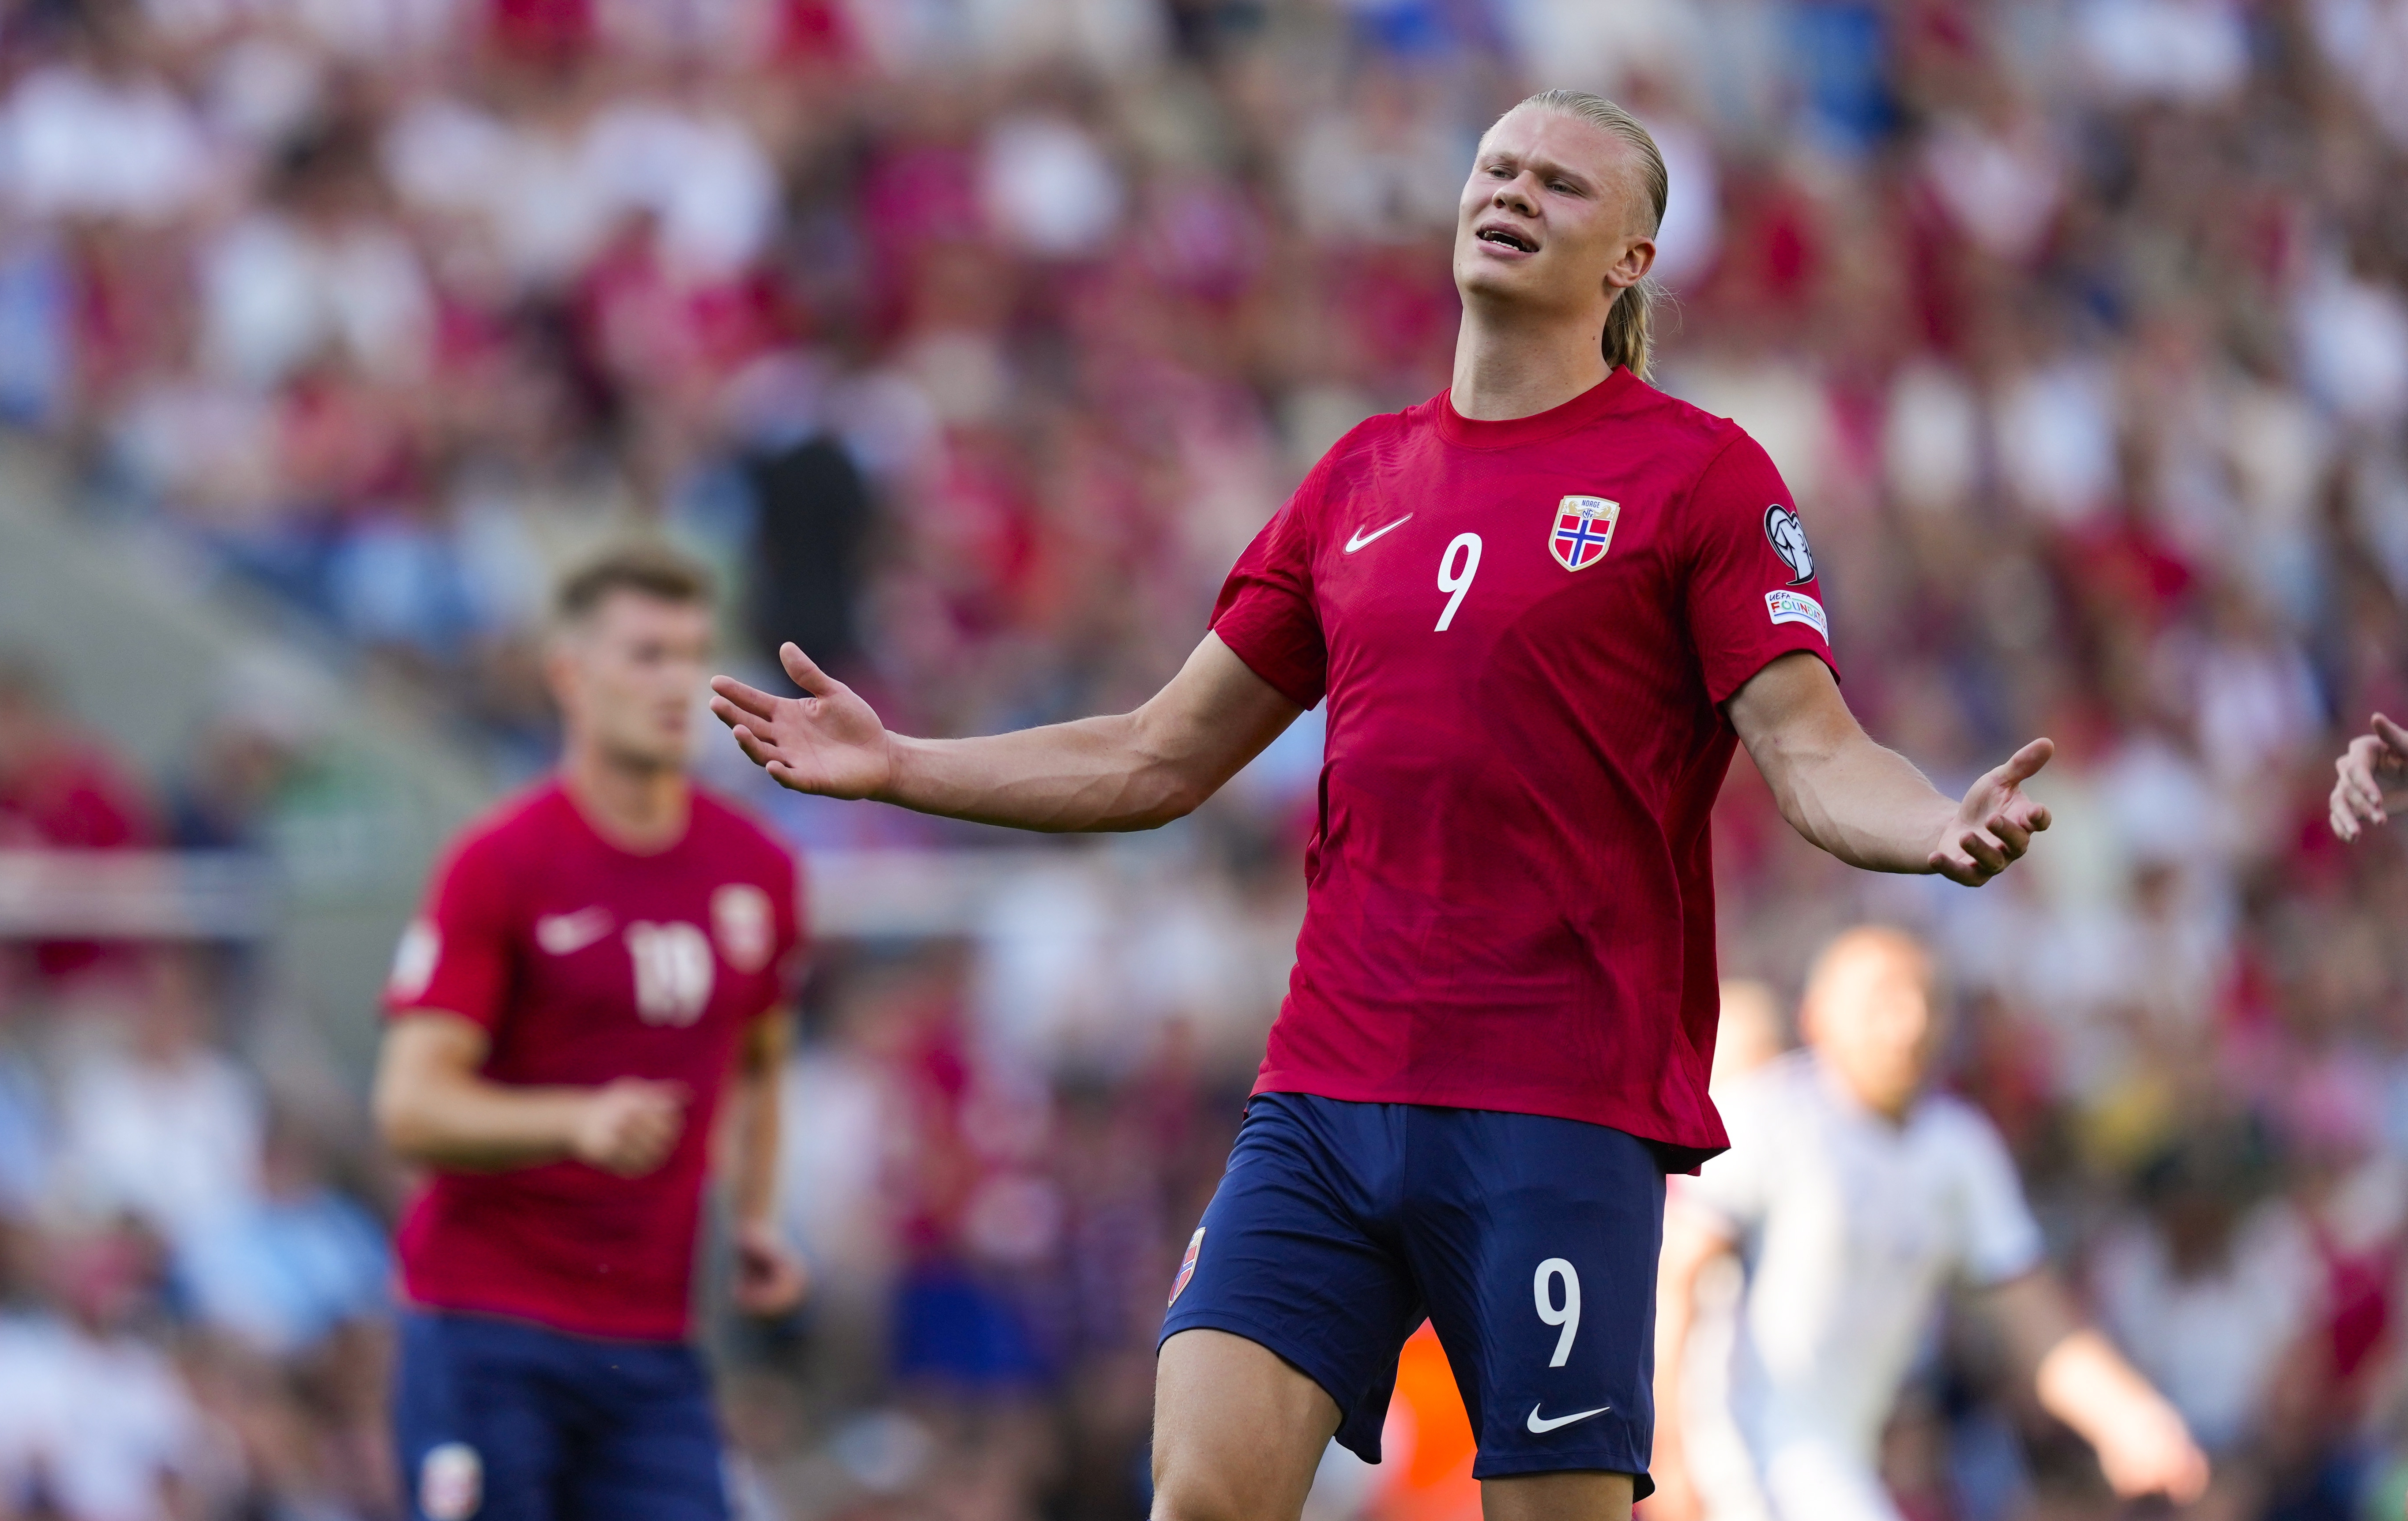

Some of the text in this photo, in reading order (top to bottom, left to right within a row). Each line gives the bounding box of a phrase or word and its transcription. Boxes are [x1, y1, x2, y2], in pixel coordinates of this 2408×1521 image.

[1581, 499, 1600, 508] NORGE
[1434, 532, 1482, 632] 9
[1769, 592, 1791, 601] UEFA
[623, 920, 714, 1026] 19
[1534, 1258, 1581, 1367] 9
